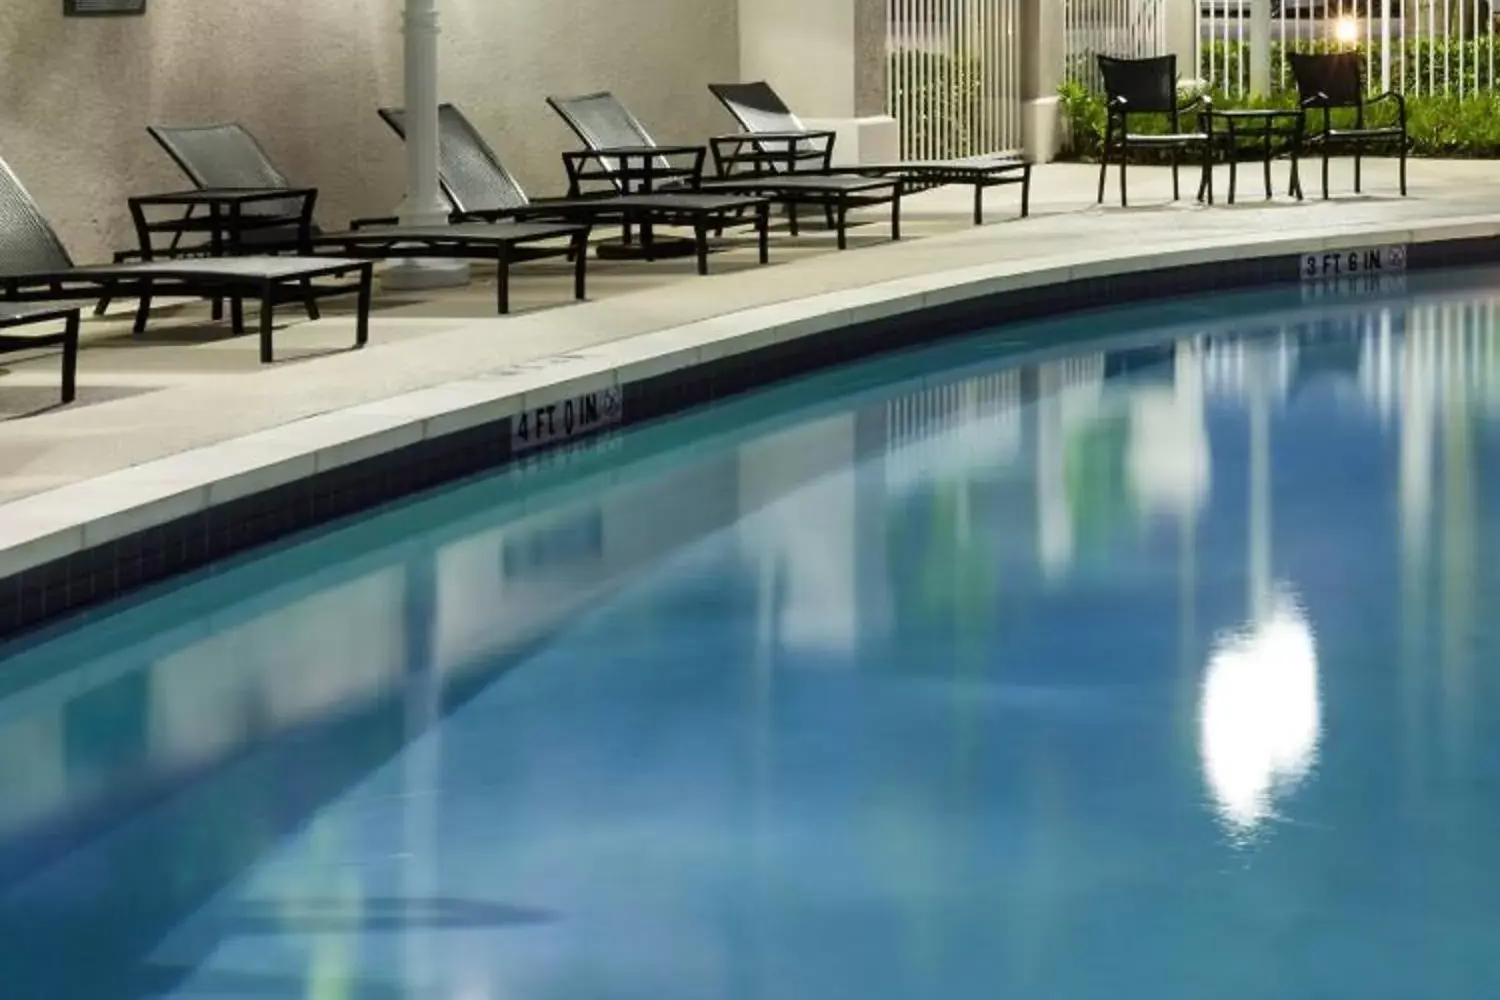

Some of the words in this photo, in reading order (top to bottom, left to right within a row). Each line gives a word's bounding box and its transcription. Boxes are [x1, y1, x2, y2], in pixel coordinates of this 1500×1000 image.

[1322, 254, 1341, 274] FT
[1364, 249, 1382, 270] IN
[536, 405, 556, 439] FT
[579, 393, 598, 425] IN
